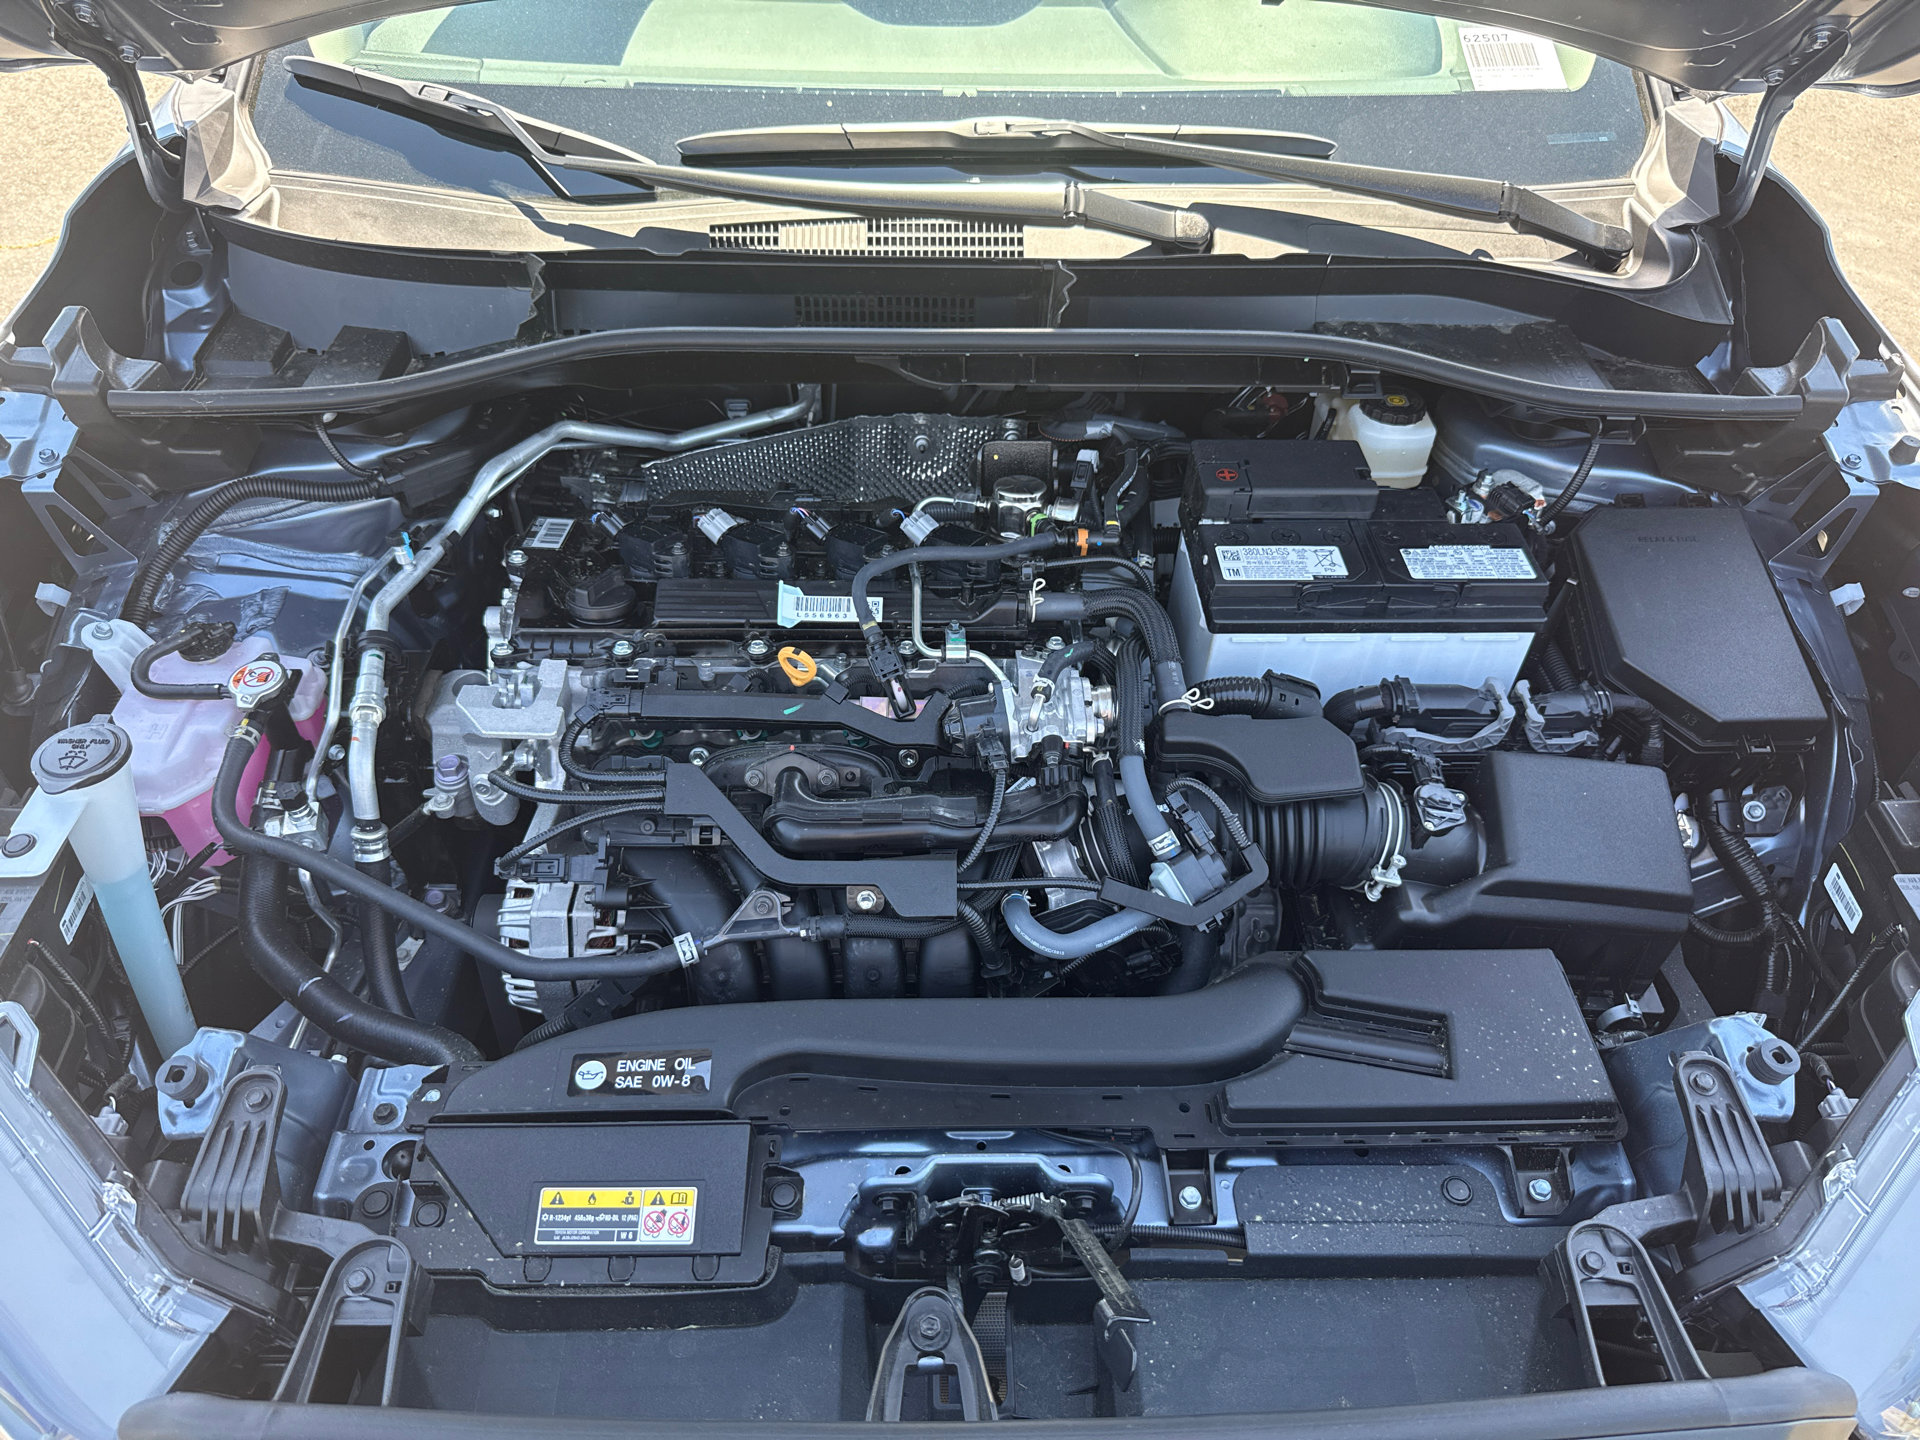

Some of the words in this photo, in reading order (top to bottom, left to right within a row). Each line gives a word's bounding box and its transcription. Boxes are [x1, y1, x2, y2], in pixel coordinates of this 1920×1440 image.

[1463, 33, 1508, 42] 62507
[1226, 568, 1241, 577] TM
[616, 1058, 667, 1072] ENGINE
[674, 1057, 697, 1071] OIL
[614, 1075, 644, 1089] SAE
[651, 1074, 691, 1088] 0W-8
